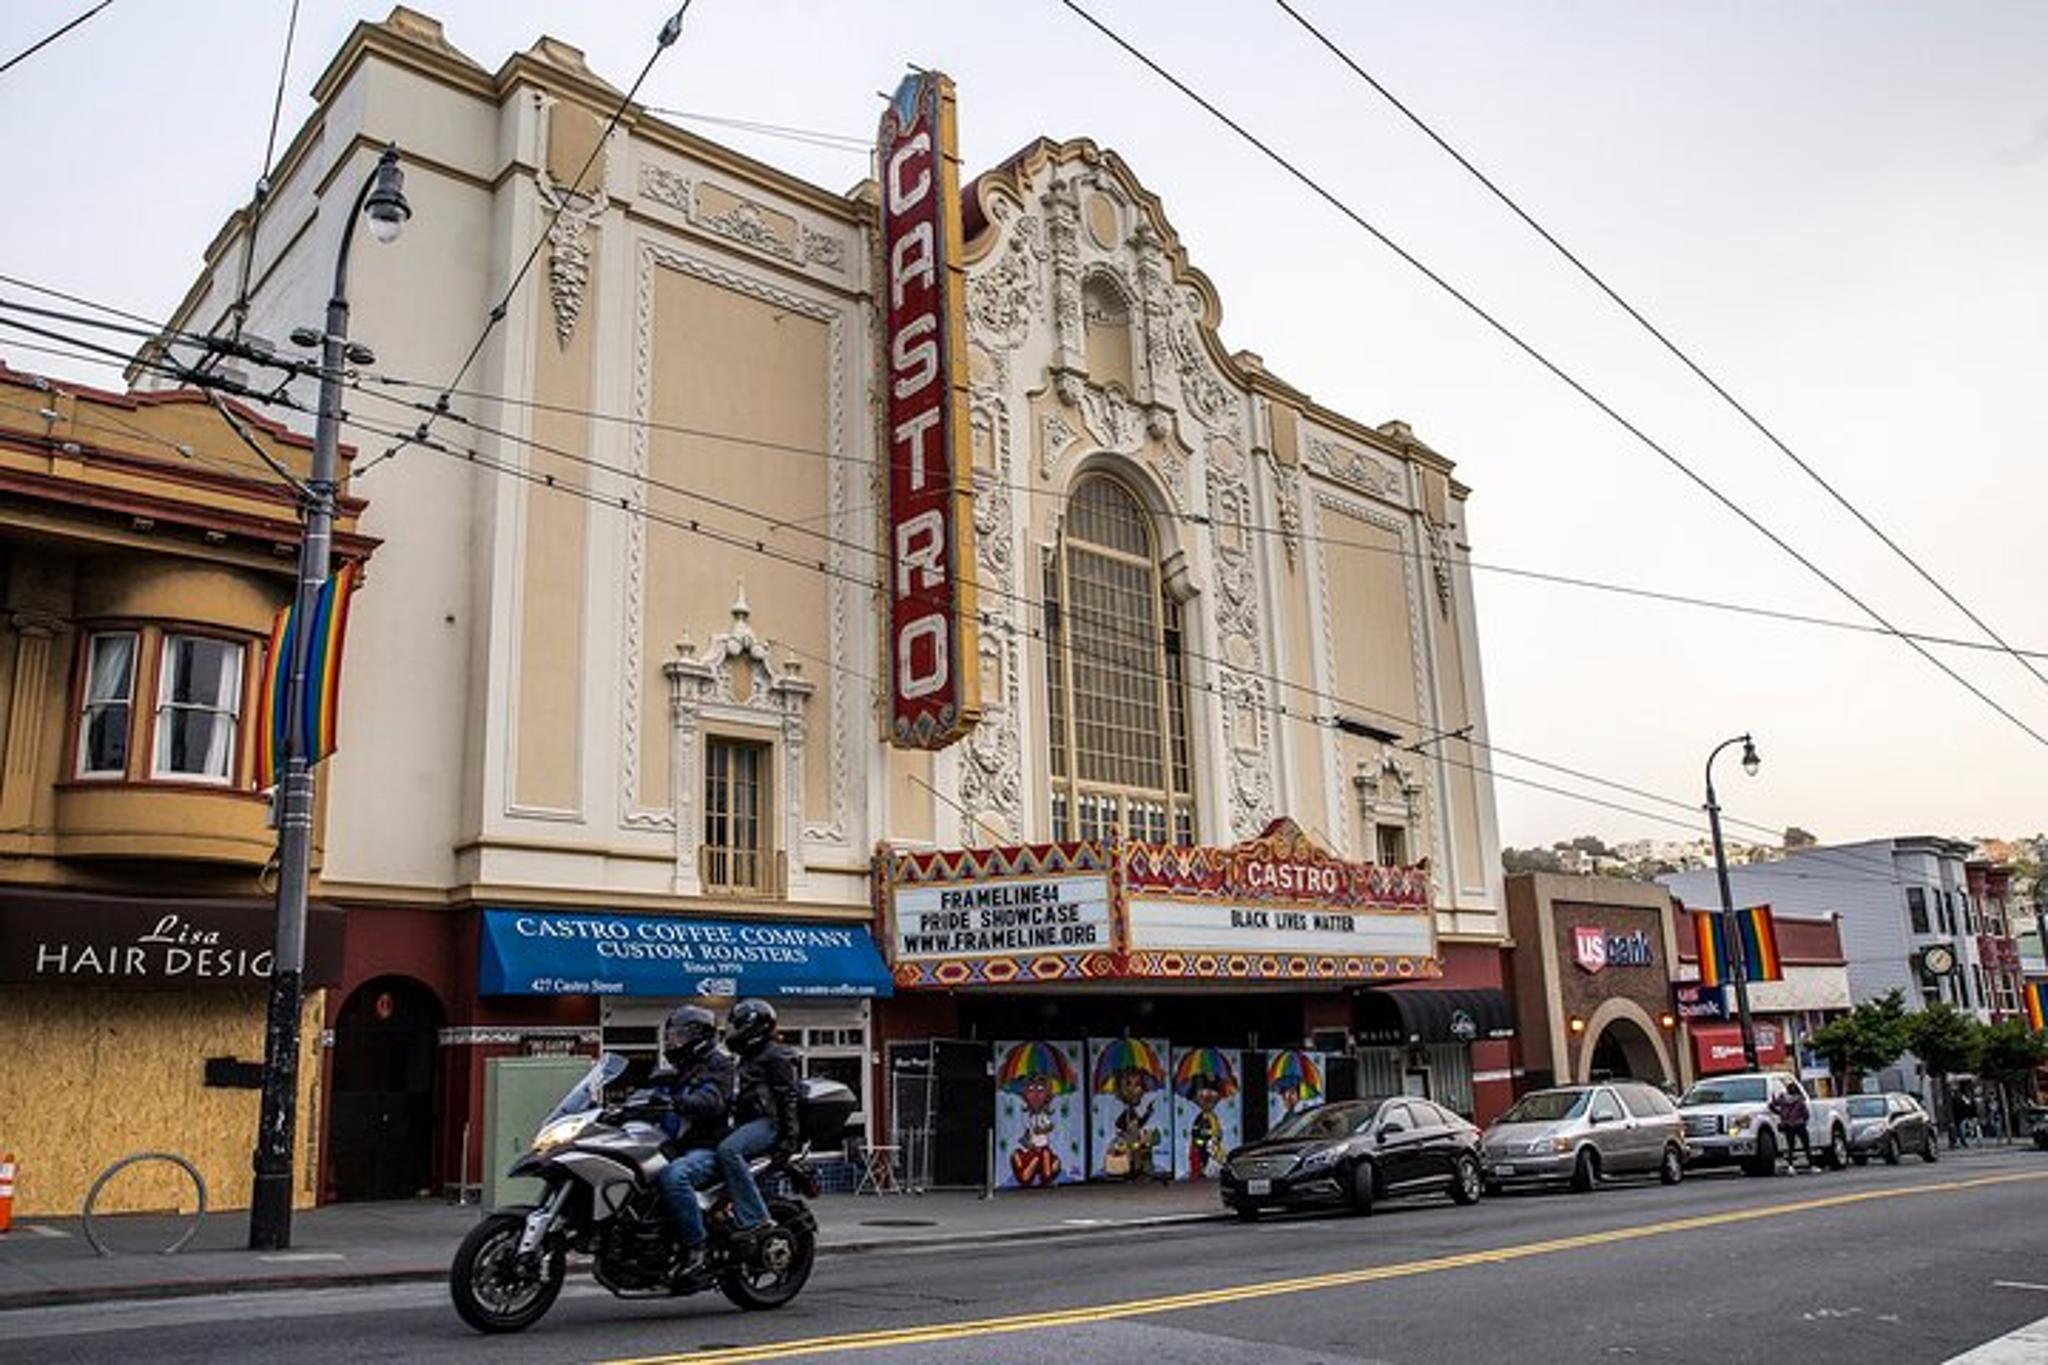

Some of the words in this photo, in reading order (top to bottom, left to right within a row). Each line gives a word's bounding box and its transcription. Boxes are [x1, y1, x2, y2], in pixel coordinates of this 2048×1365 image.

[888, 132, 948, 700] CASTRO
[1248, 861, 1337, 893] CASTRO
[940, 885, 1059, 909] FRAMELINE44
[138, 915, 220, 945] Lisa
[920, 911, 970, 931] PRIDE
[980, 904, 1079, 928] SHOWCASE
[1231, 910, 1269, 928] BLACK
[1275, 913, 1306, 930] LIVES
[1313, 915, 1355, 932] MATTER
[516, 918, 630, 939] CASTRO
[637, 924, 736, 943] COFFEE
[739, 927, 853, 948] COMPANY
[36, 944, 147, 975] HAIR
[165, 949, 274, 976] DESIG
[597, 941, 694, 959] CUSTOM
[700, 944, 808, 963] ROASTERS
[1577, 935, 1606, 962] US
[1607, 929, 1653, 967] bank
[554, 979, 590, 993] Castro
[591, 980, 624, 993] Street
[1678, 987, 1699, 1003] US
[1678, 1001, 1720, 1017] bank
